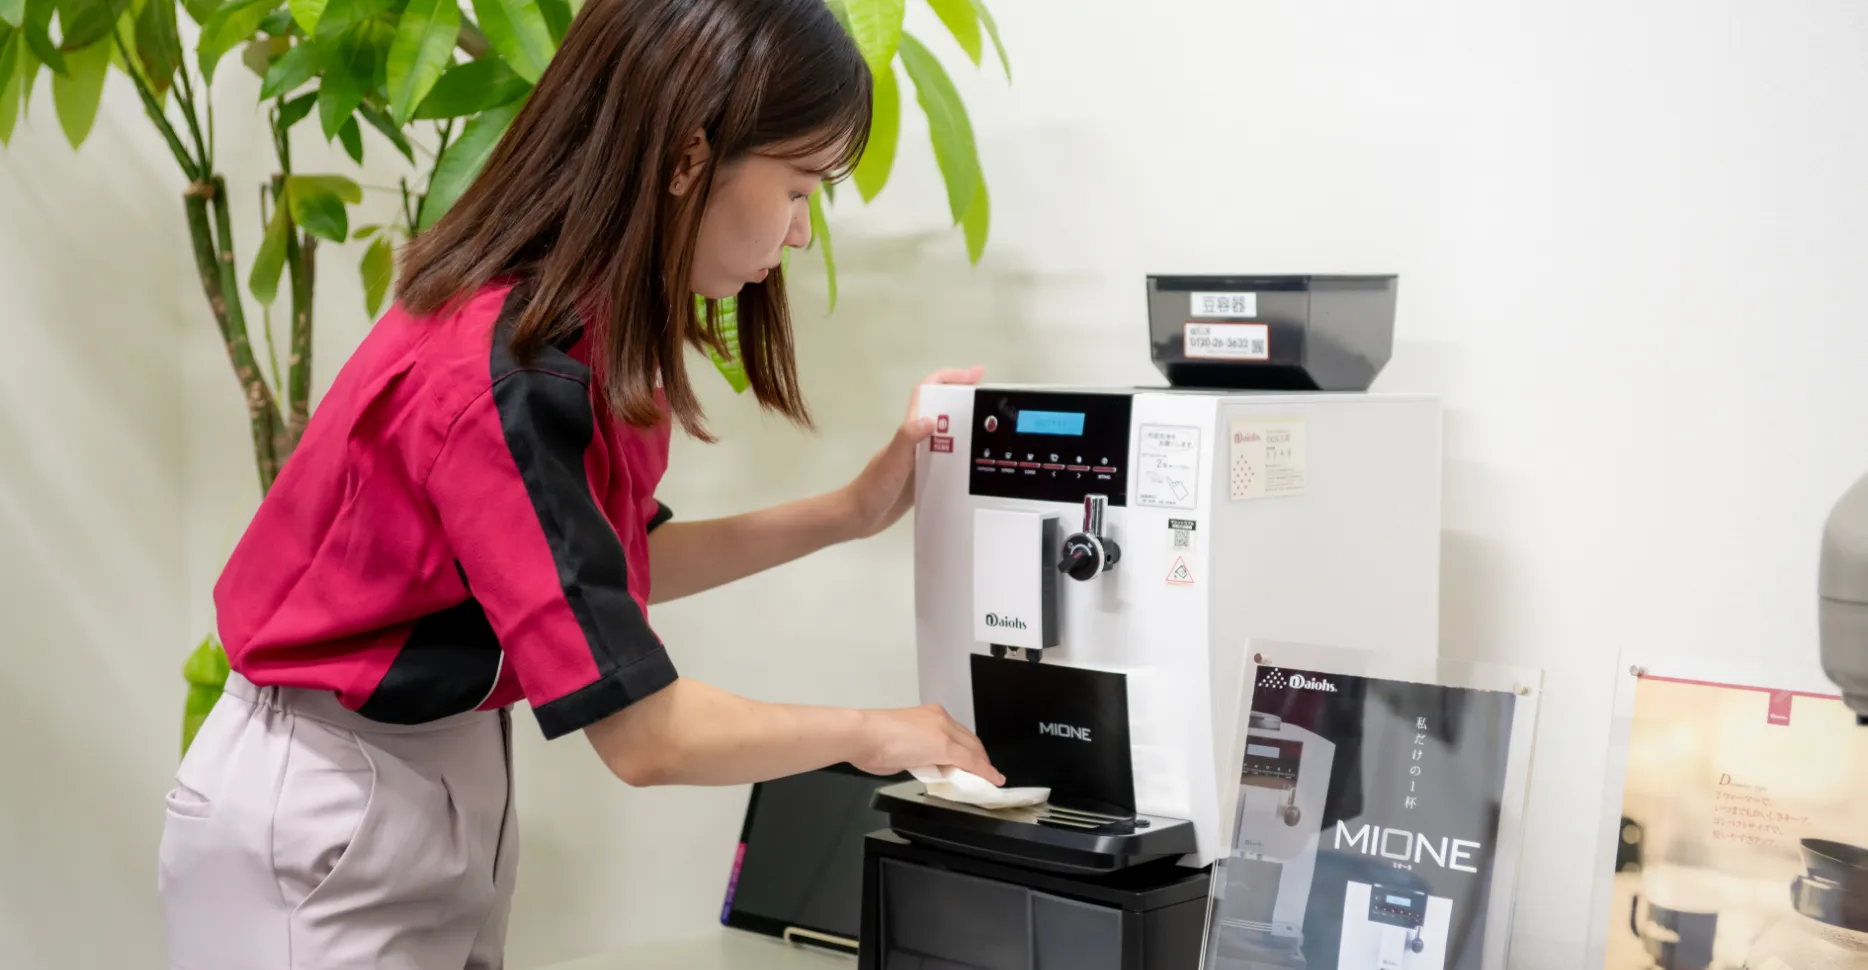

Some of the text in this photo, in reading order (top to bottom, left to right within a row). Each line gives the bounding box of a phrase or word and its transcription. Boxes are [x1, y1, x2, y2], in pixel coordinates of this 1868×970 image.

[1202, 296, 1246, 313] 豆容器
[1189, 337, 1249, 349] 0120-26-3632
[985, 612, 1028, 631] Daiohs
[1288, 673, 1338, 693] Daiohs
[1038, 721, 1093, 742] MIONE
[1334, 819, 1482, 873] MIONE
